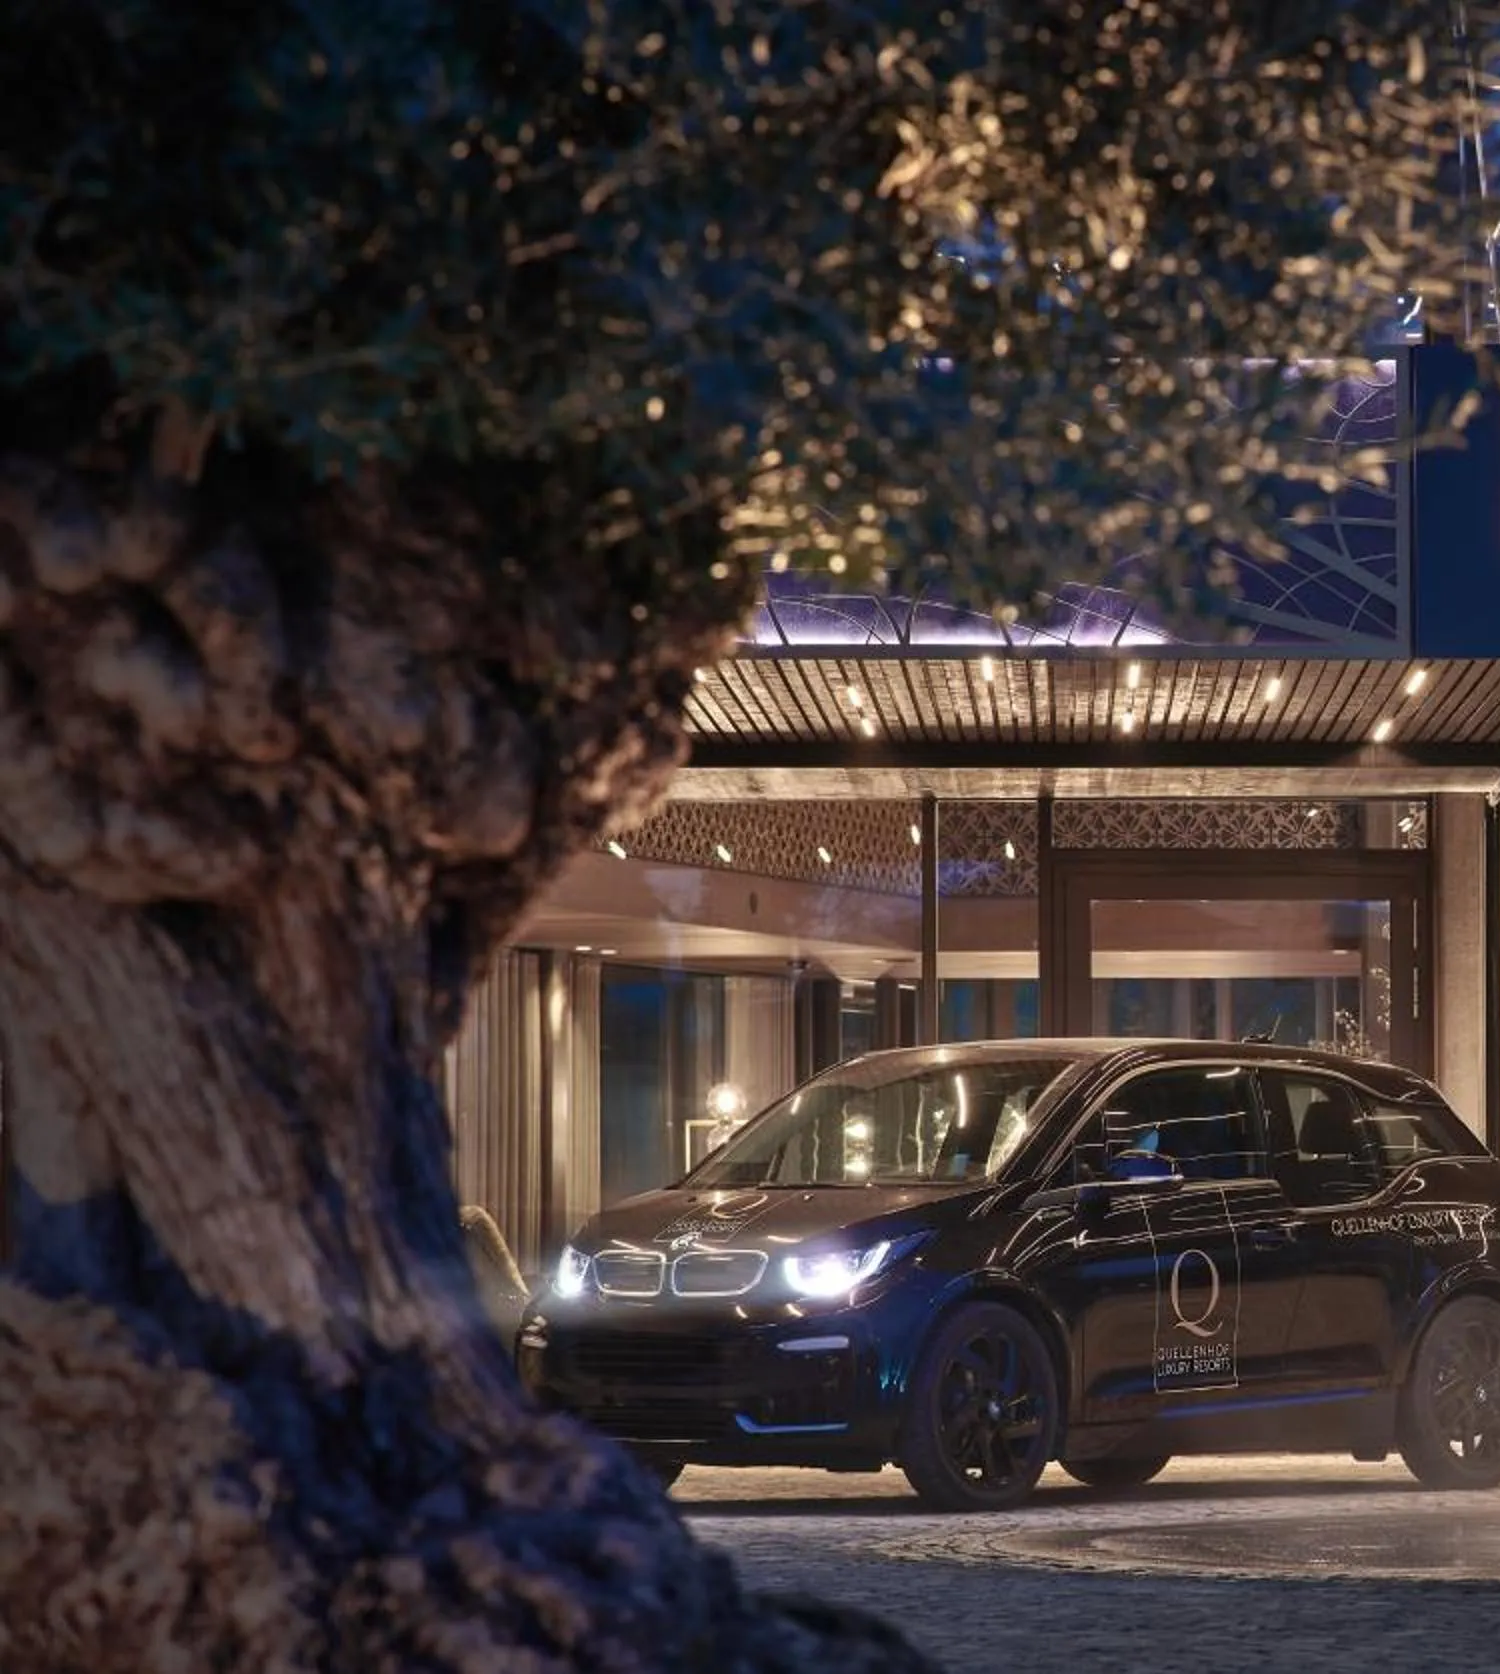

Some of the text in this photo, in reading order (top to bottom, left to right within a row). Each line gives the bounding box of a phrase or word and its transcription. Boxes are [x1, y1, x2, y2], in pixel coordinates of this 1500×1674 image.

[1171, 1249, 1223, 1336] Q
[1157, 1343, 1231, 1361] QUELLENHOF
[1157, 1360, 1191, 1377] LUXURY
